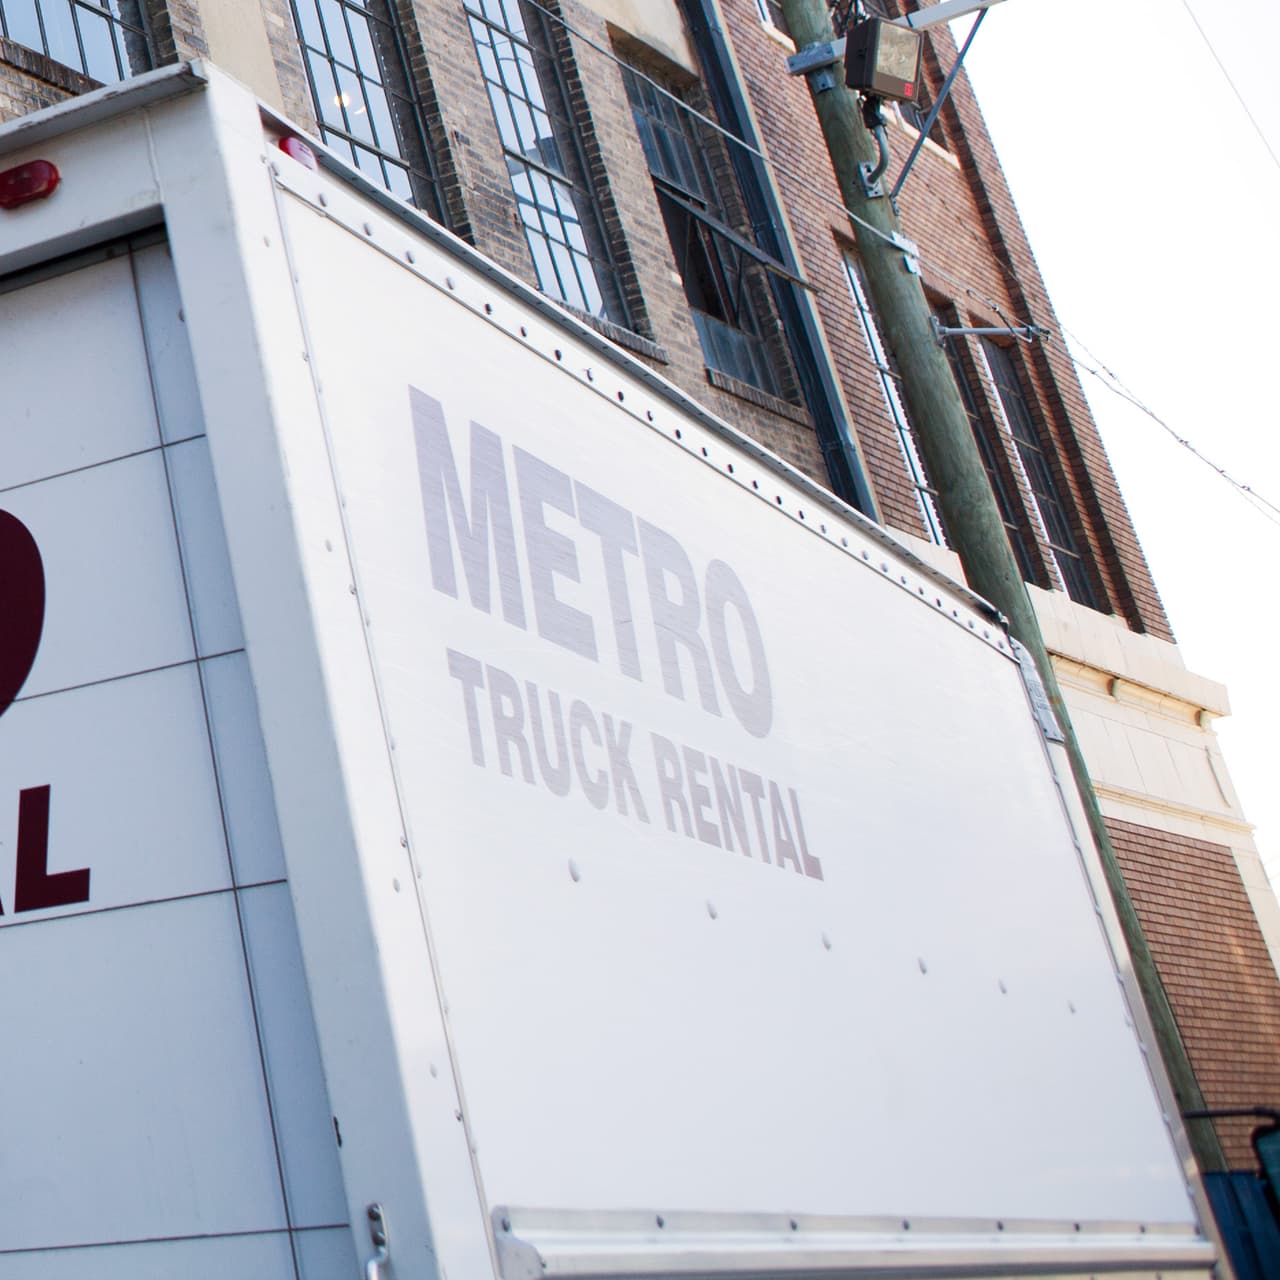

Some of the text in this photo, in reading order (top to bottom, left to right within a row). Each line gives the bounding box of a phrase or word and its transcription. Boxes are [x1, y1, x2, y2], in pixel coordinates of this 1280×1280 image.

[409, 385, 773, 739] METRO
[447, 649, 824, 881] TRUCK RENTAL
